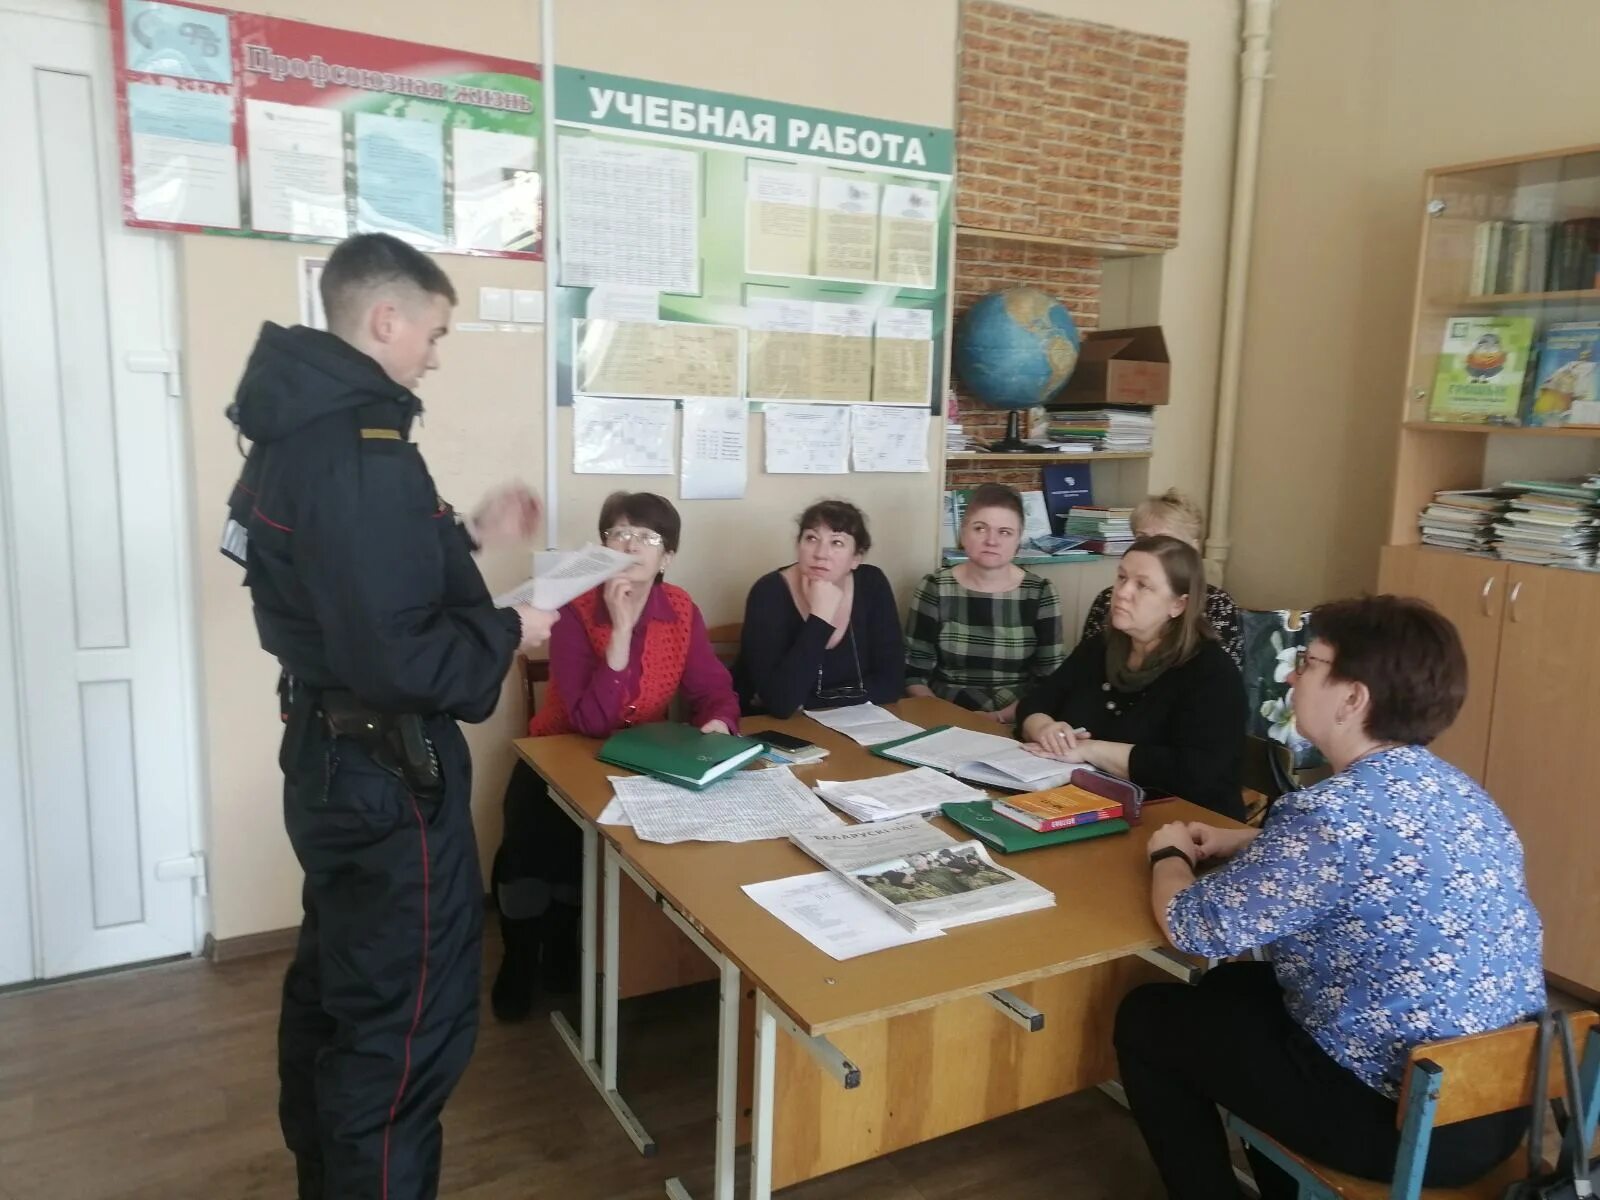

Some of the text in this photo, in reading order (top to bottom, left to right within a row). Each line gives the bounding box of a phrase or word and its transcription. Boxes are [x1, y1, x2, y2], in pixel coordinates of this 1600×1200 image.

[244, 43, 533, 113] Профсоюзная жизнь
[588, 86, 927, 166] УЧЕБНАЯ РАБОТА
